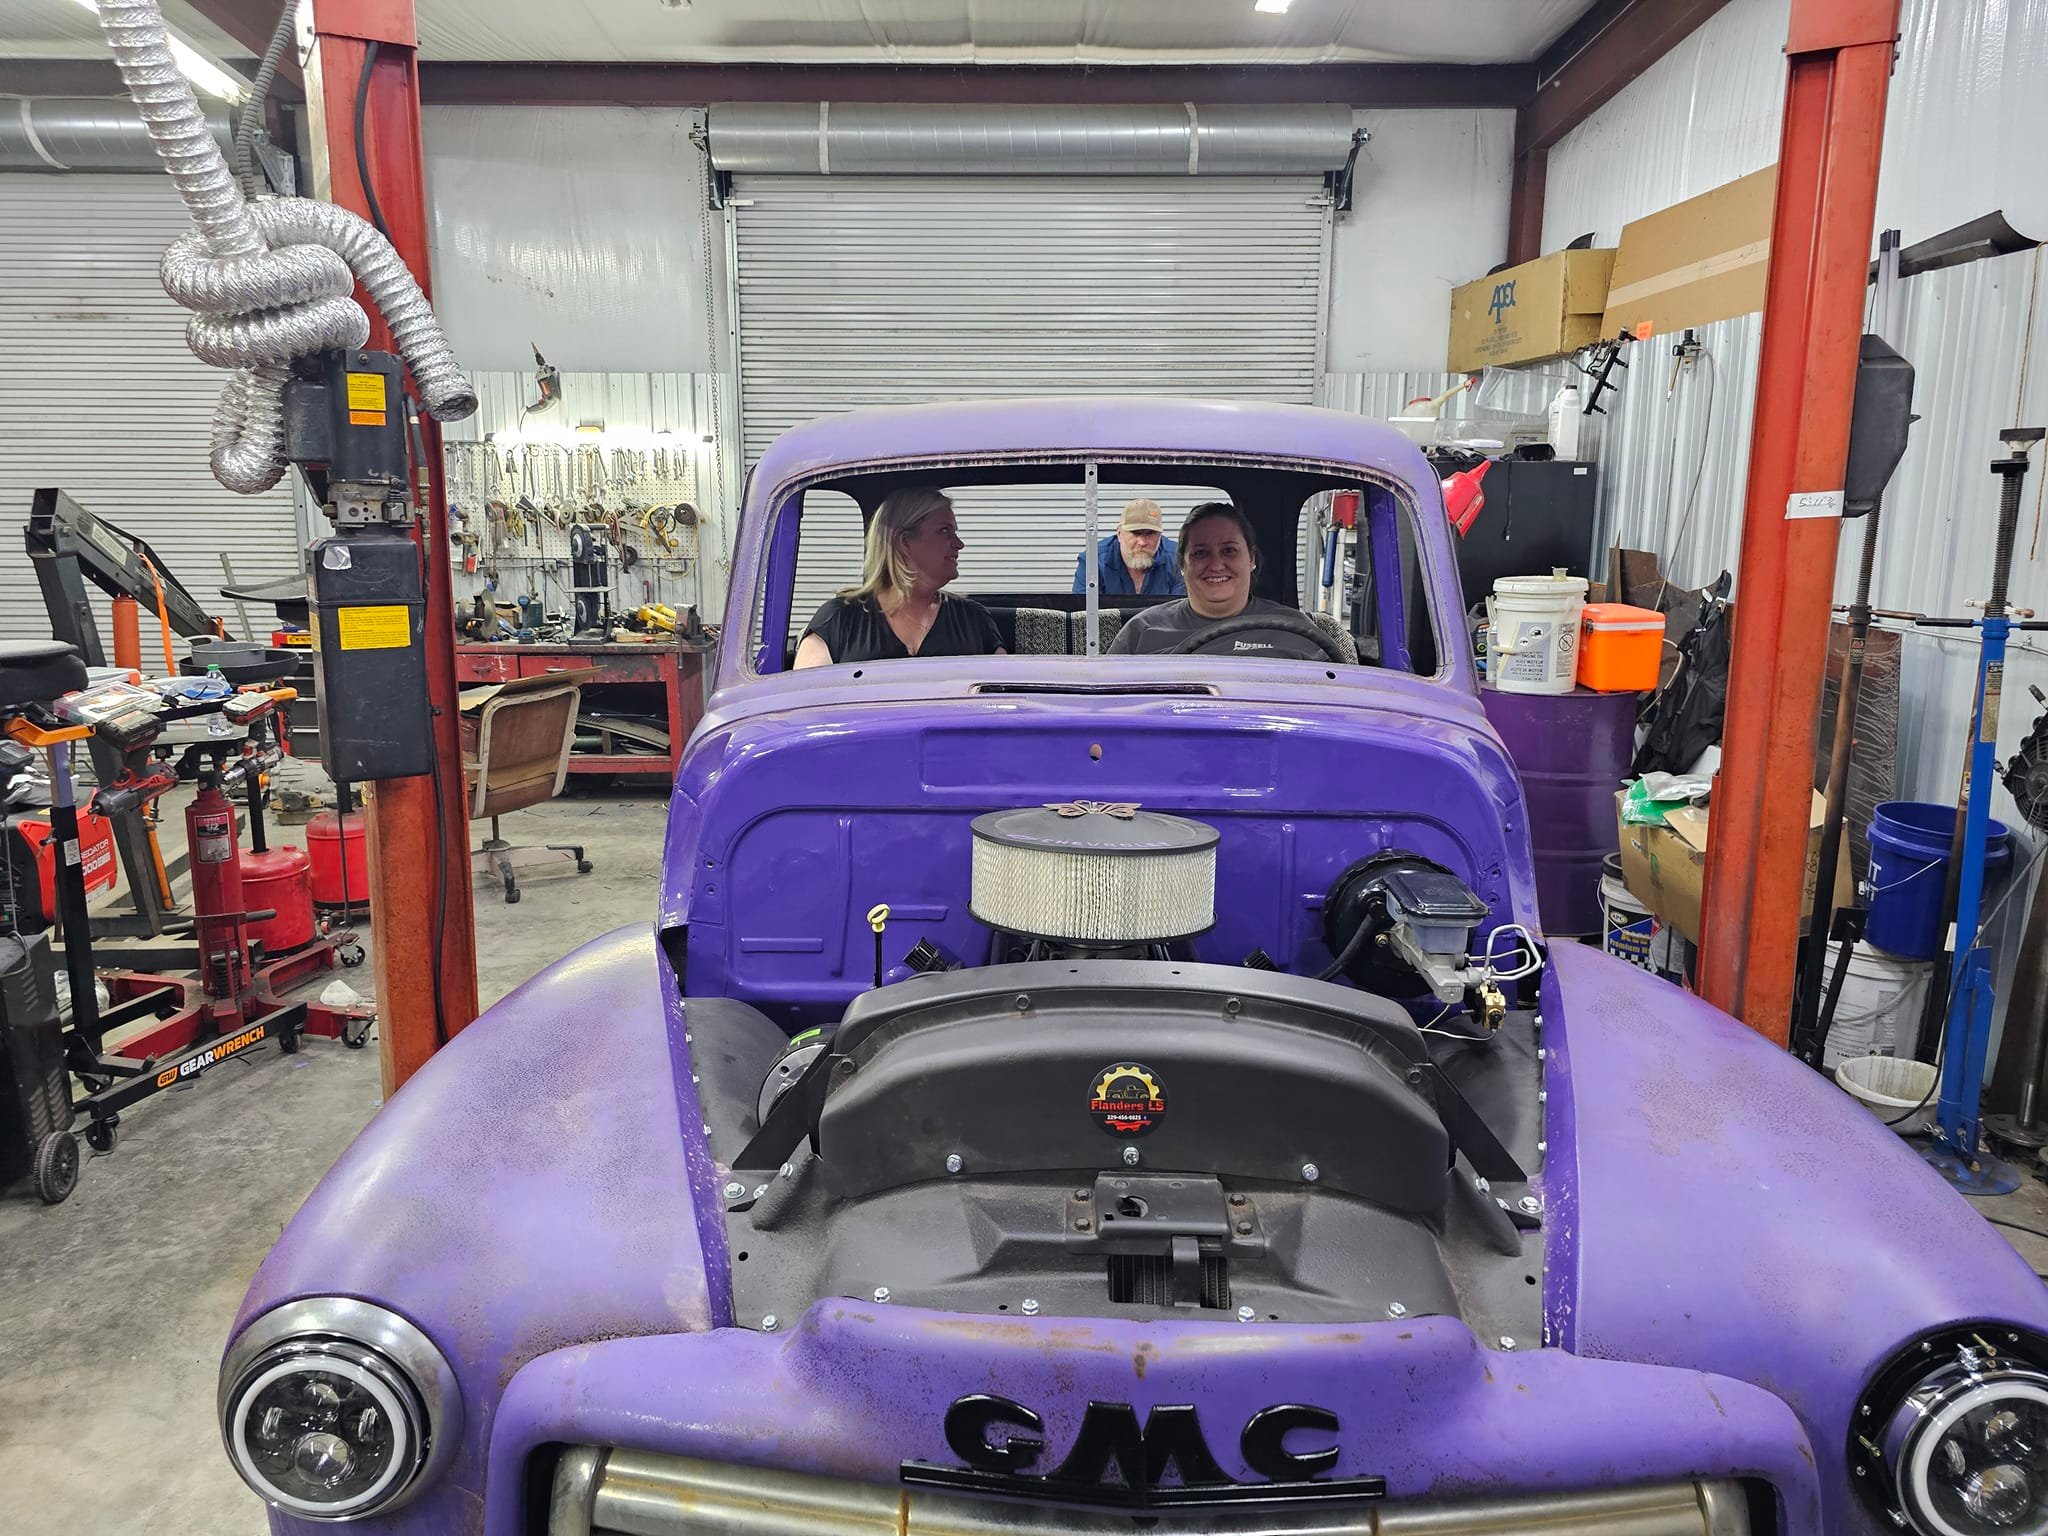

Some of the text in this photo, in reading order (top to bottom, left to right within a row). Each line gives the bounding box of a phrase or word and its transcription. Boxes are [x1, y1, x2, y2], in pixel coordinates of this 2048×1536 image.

[1040, 837, 1171, 848] CHEVROLET
[180, 1026, 265, 1077] GEARWRENCH
[1091, 1100, 1165, 1111] Flanders LS
[944, 1393, 1340, 1489] GMC
